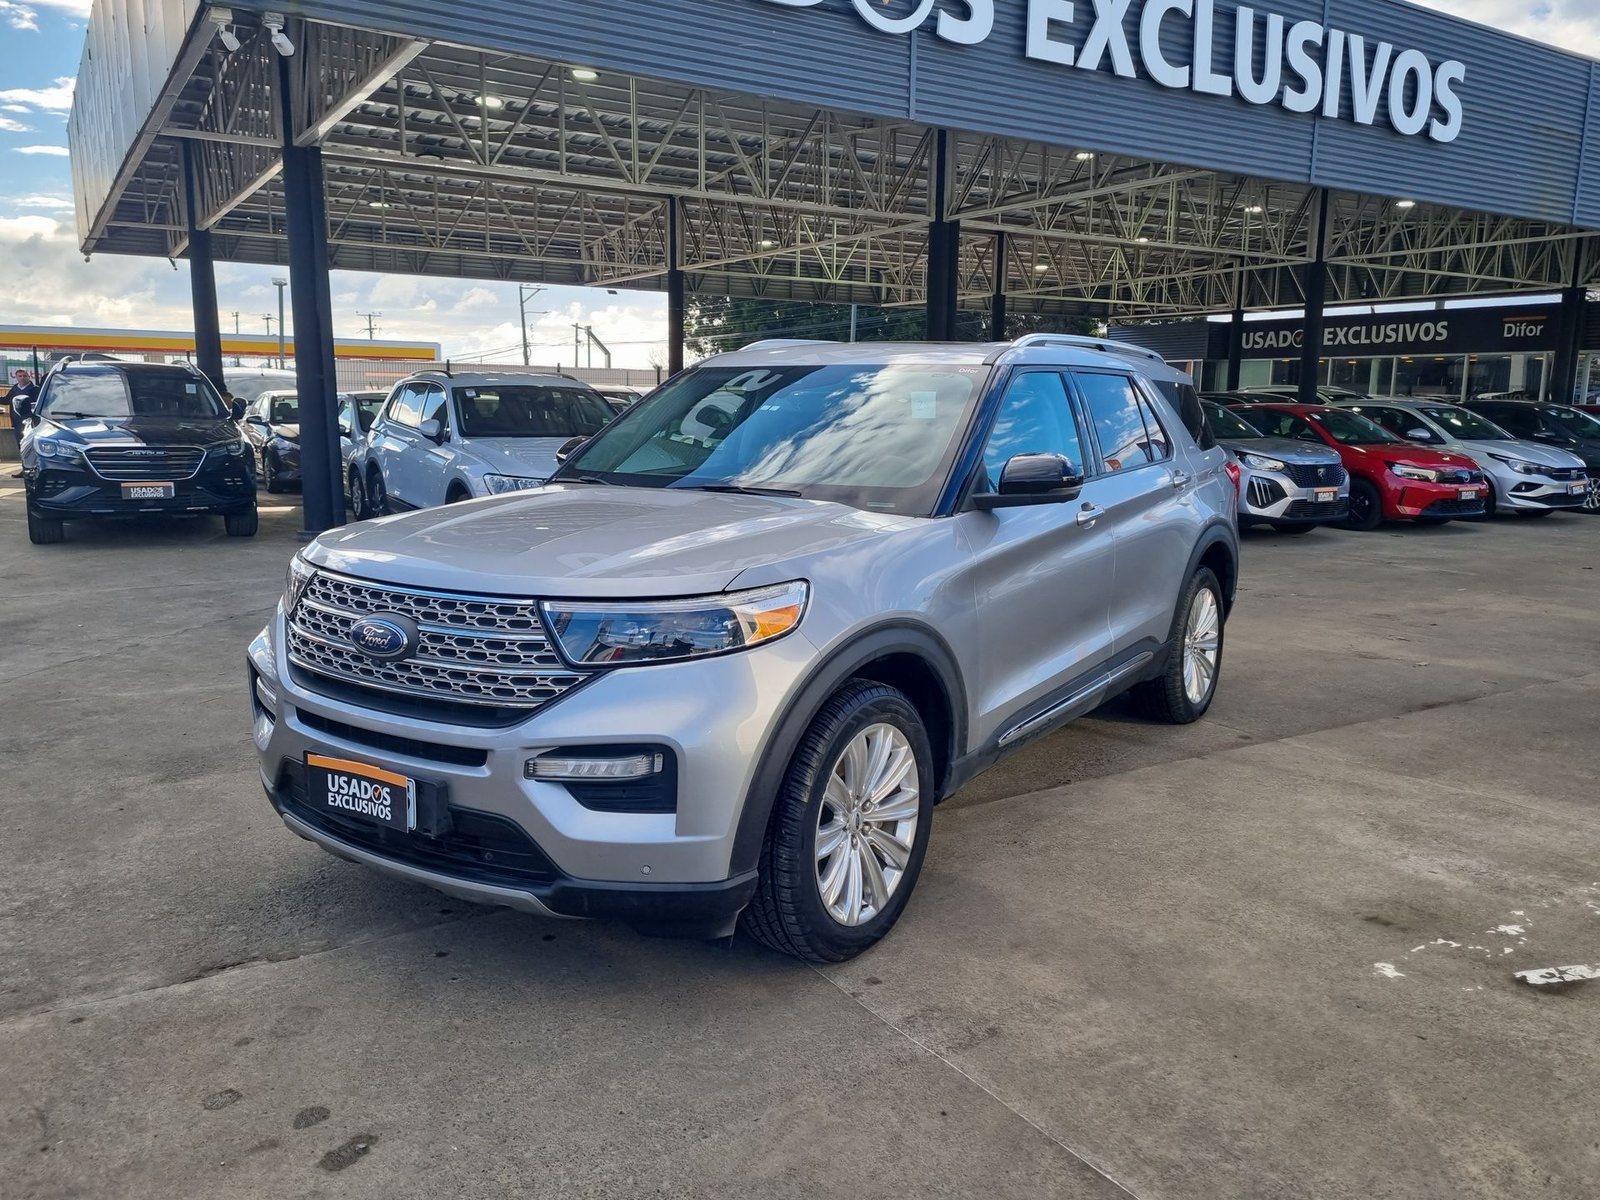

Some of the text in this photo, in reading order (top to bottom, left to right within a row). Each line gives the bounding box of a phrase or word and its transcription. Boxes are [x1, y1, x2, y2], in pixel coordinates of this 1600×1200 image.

[1026, 0, 1467, 143] EXCLUSIVOS
[1241, 321, 1449, 349] USADO EXCLUSIVOS
[1503, 323, 1544, 337] Difor
[130, 486, 164, 494] USADOS
[360, 626, 391, 648] Ford
[327, 773, 391, 806] USADOS
[327, 792, 392, 820] EXCLUSIVOS
